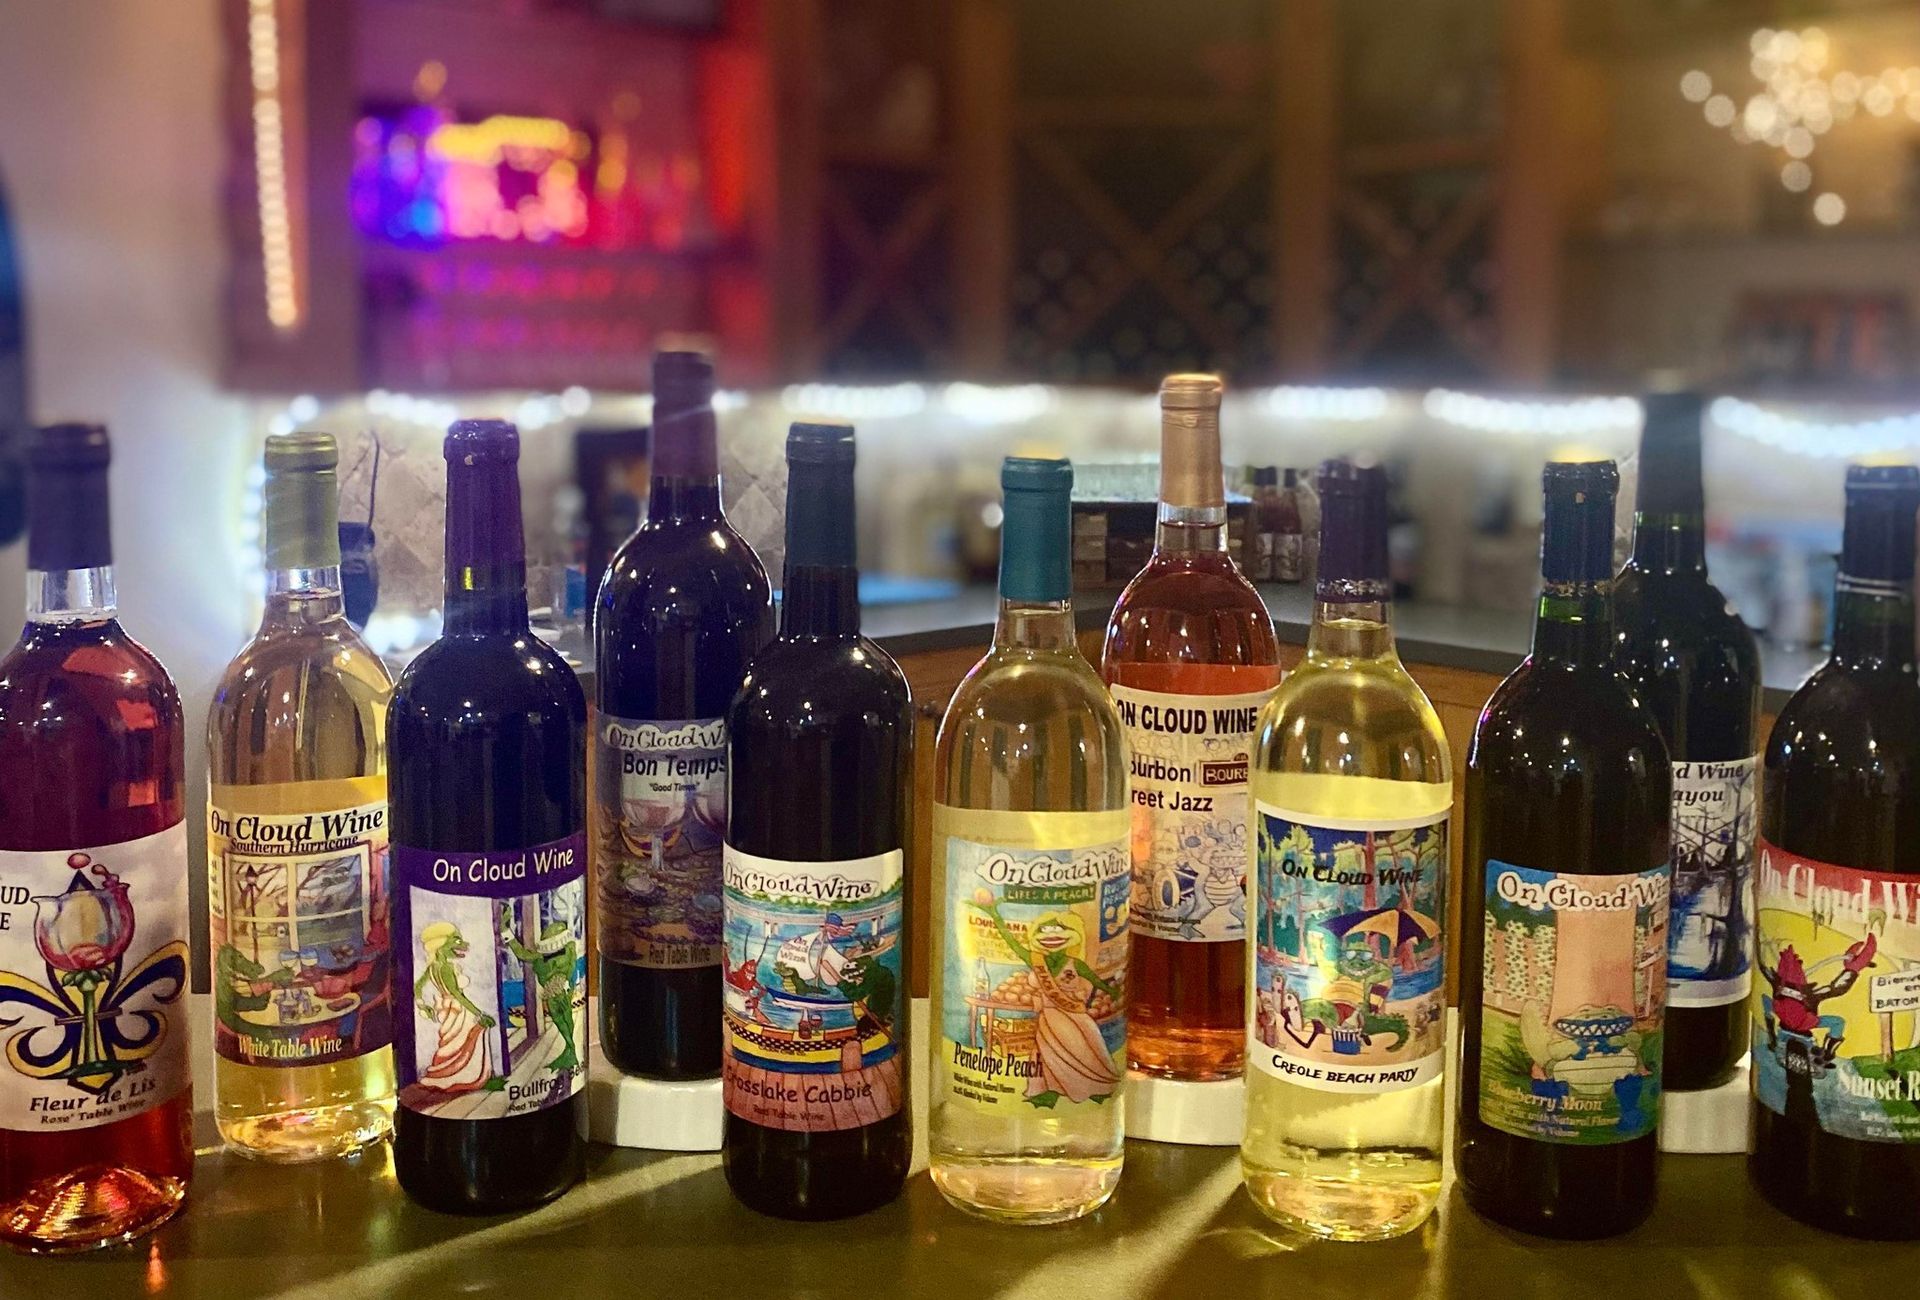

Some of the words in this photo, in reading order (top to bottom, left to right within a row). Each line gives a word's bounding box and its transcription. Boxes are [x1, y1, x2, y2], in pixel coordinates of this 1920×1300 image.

[1141, 705, 1207, 734] CLOUD
[1213, 707, 1258, 734] WINE
[609, 727, 634, 748] On
[637, 728, 698, 748] Cloud
[699, 725, 724, 747] W
[623, 753, 657, 776] Bon
[1698, 763, 1744, 779] Wine
[1169, 791, 1213, 812] Jazz
[211, 810, 231, 837] On
[236, 815, 313, 842] Cloud
[321, 809, 383, 836] Wine
[231, 837, 284, 854] Southern
[288, 836, 359, 854] Hurricane
[433, 859, 461, 882] On
[468, 854, 526, 882] Cloud
[533, 848, 574, 875] Wine
[990, 859, 1025, 884] On
[1028, 858, 1092, 883] Cloud
[725, 862, 744, 890] On
[744, 872, 811, 895] Cloud
[812, 877, 872, 899] Wine
[1501, 875, 1537, 904] On
[1549, 883, 1627, 909] Cloud
[1788, 863, 1872, 925] Cloud
[237, 1033, 270, 1057] White
[271, 1037, 307, 1058] Table
[309, 1034, 342, 1057] Wine
[953, 1041, 1003, 1081] Penelope
[1004, 1052, 1044, 1079] Peach
[726, 1065, 798, 1102] Crosslake
[804, 1079, 873, 1104] Cabbie
[1325, 1071, 1376, 1084] BEACH
[1379, 1066, 1419, 1083] PARTY
[29, 1096, 89, 1112] Fleur
[95, 1087, 122, 1106] de
[129, 1078, 157, 1098] Lis
[1561, 1094, 1603, 1112] Moon
[78, 1107, 114, 1121] Table
